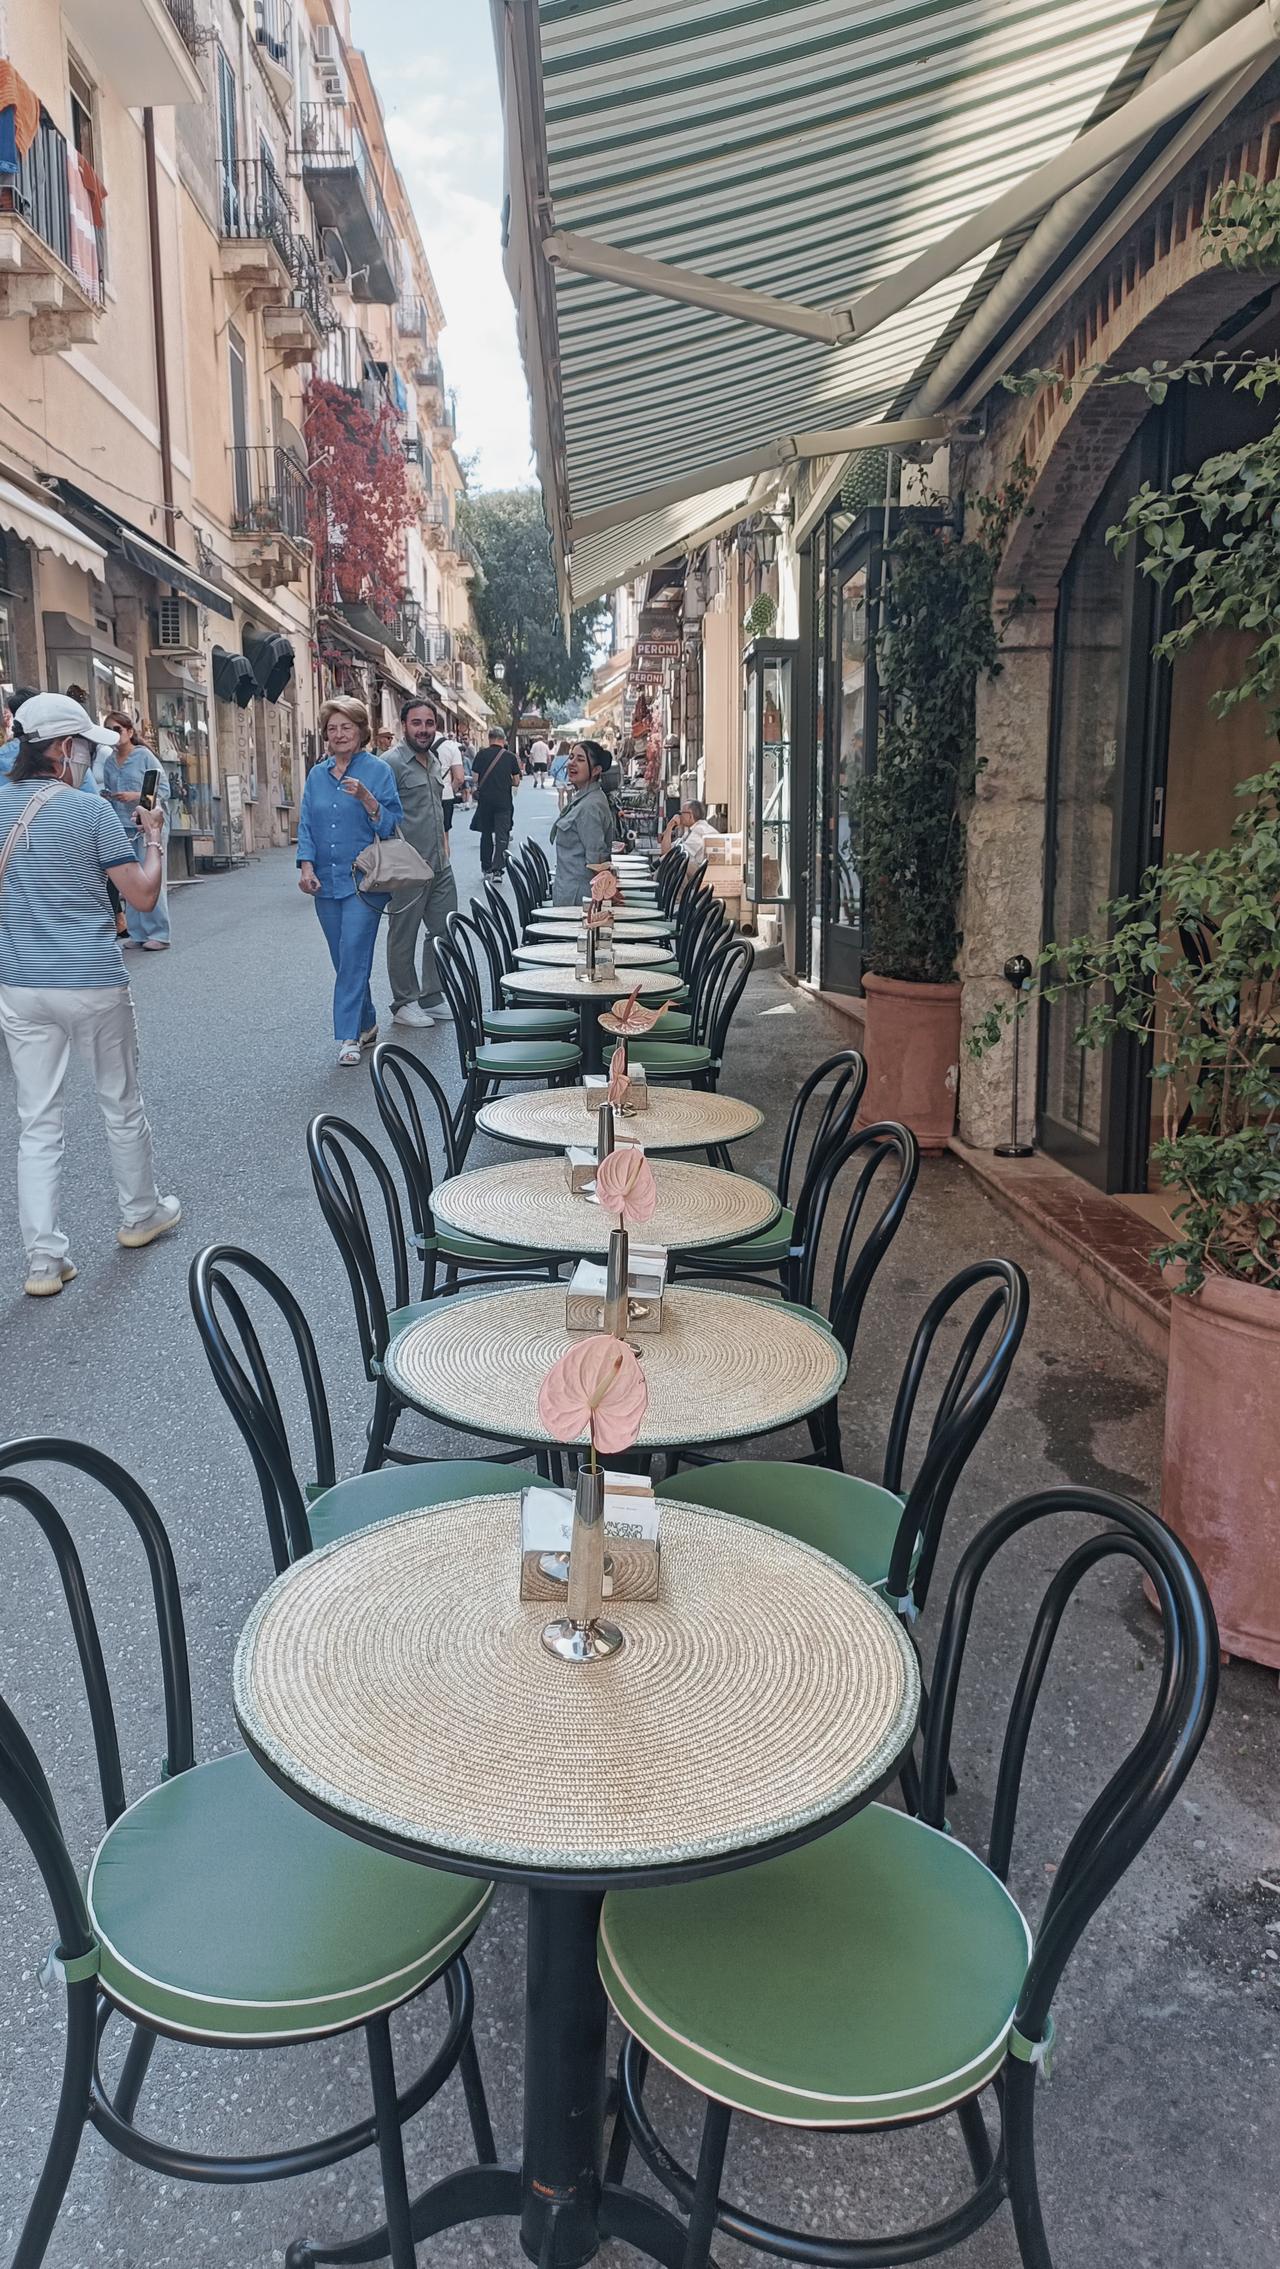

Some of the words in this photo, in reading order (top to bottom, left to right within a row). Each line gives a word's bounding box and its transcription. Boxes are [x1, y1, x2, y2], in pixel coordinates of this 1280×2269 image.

[637, 644, 677, 654] PERONI
[629, 673, 663, 683] PERONI
[268, 710, 279, 794] OTTICA
